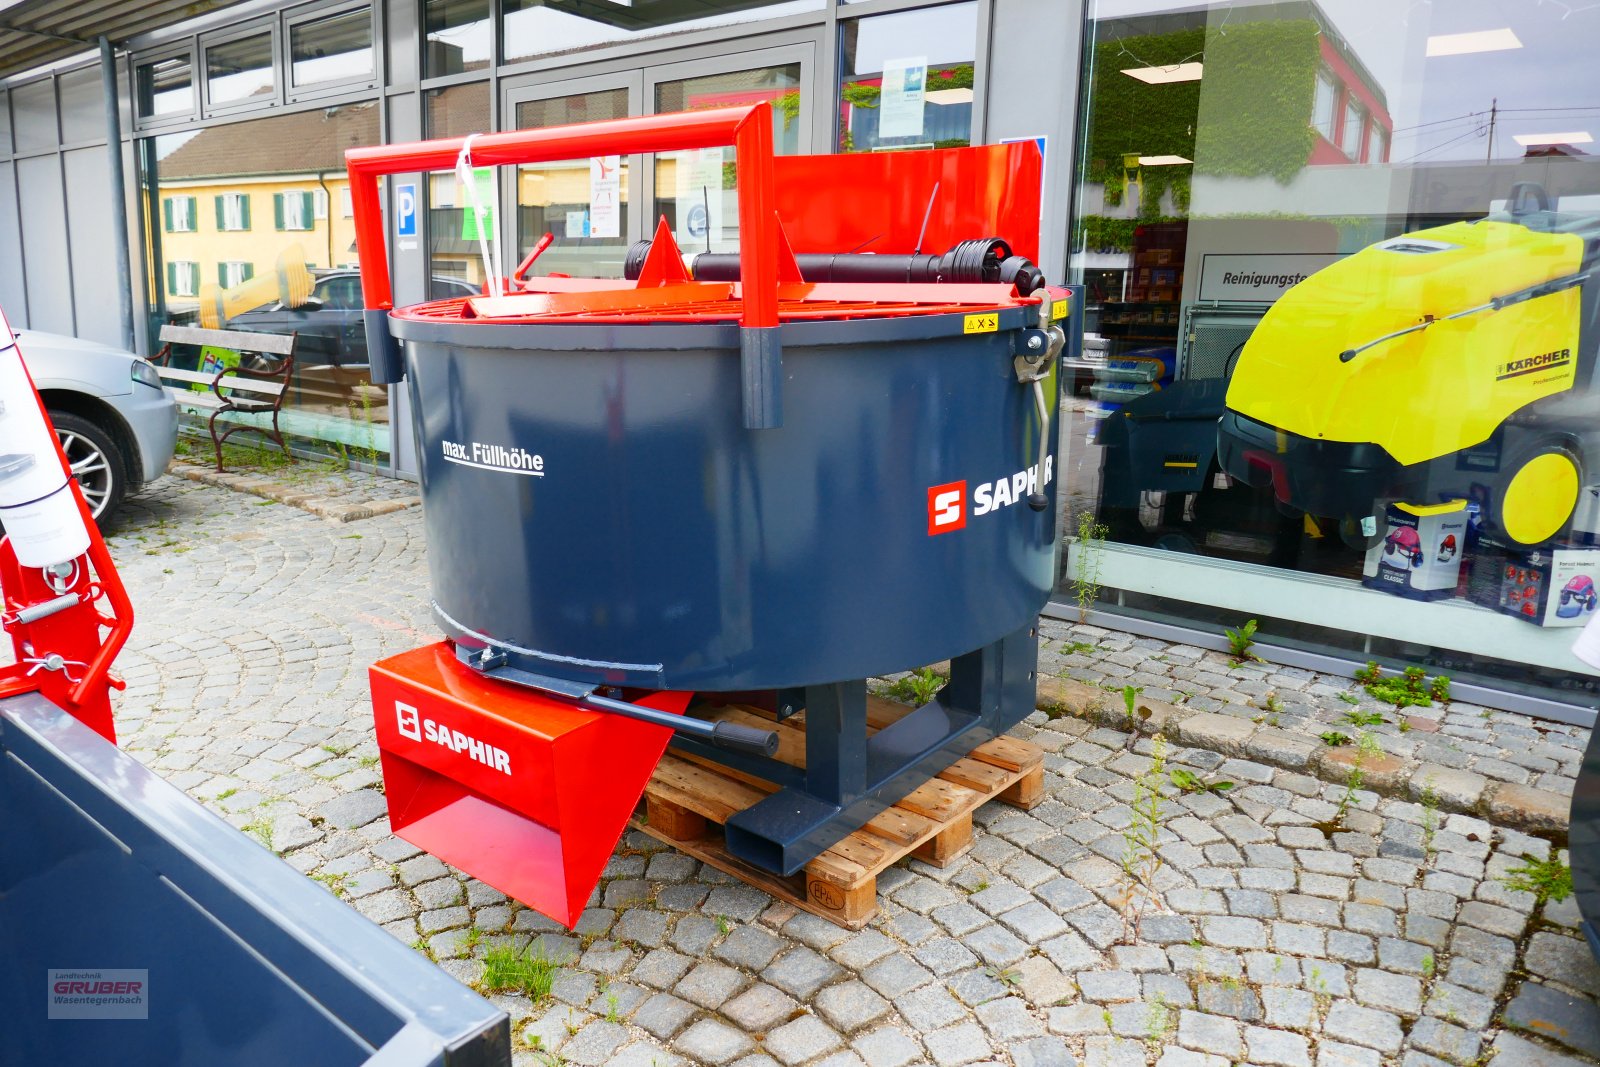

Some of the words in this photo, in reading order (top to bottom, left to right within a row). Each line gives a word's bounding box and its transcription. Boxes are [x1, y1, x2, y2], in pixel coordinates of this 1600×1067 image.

[399, 192, 414, 229] P
[1506, 348, 1570, 372] KÄRCHER
[442, 440, 470, 461] max.
[472, 442, 544, 471] Füllhöhe
[973, 454, 1053, 516] SAPHR
[423, 718, 512, 776] SAPHIR
